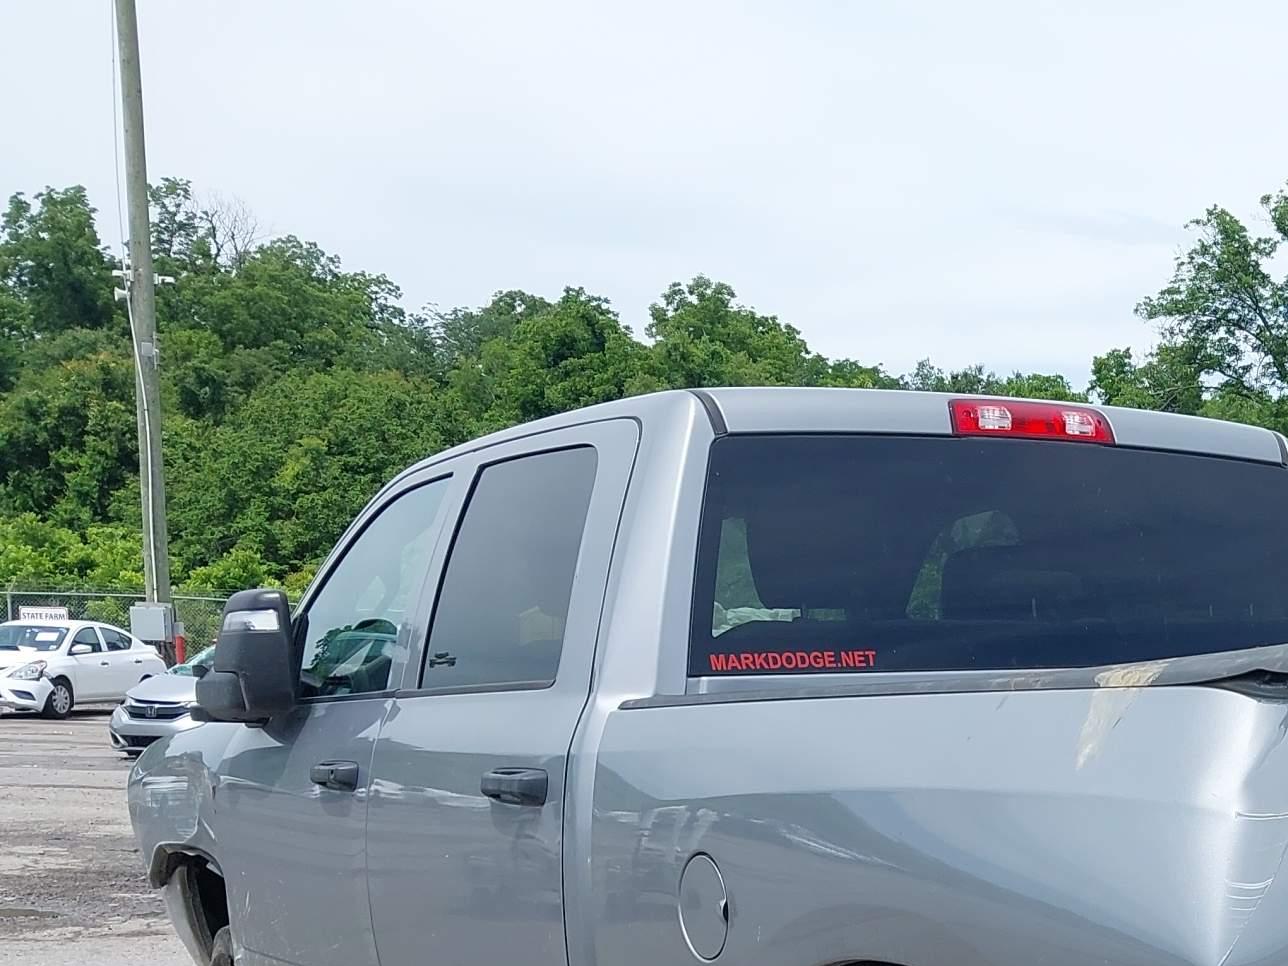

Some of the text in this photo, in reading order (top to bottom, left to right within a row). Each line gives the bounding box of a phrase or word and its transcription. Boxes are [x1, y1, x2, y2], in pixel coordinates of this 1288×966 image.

[22, 612, 66, 621] STATE FARM
[709, 651, 876, 671] MARKDODGE.NET
